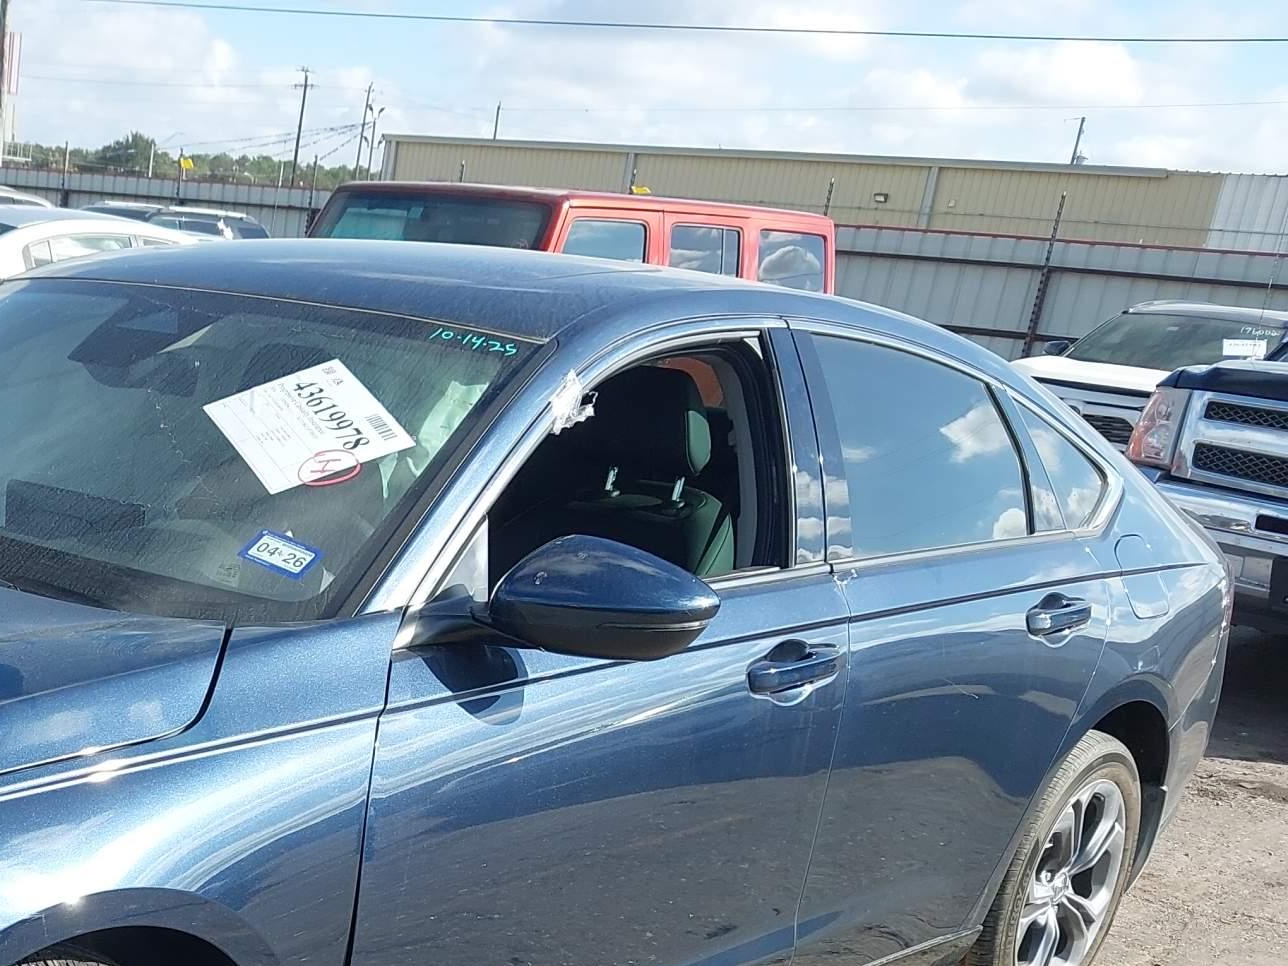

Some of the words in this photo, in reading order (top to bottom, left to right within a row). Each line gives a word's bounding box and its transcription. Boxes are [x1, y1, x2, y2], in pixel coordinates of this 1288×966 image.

[293, 381, 370, 450] 43619978
[256, 542, 279, 557] 04
[281, 552, 307, 568] 26
